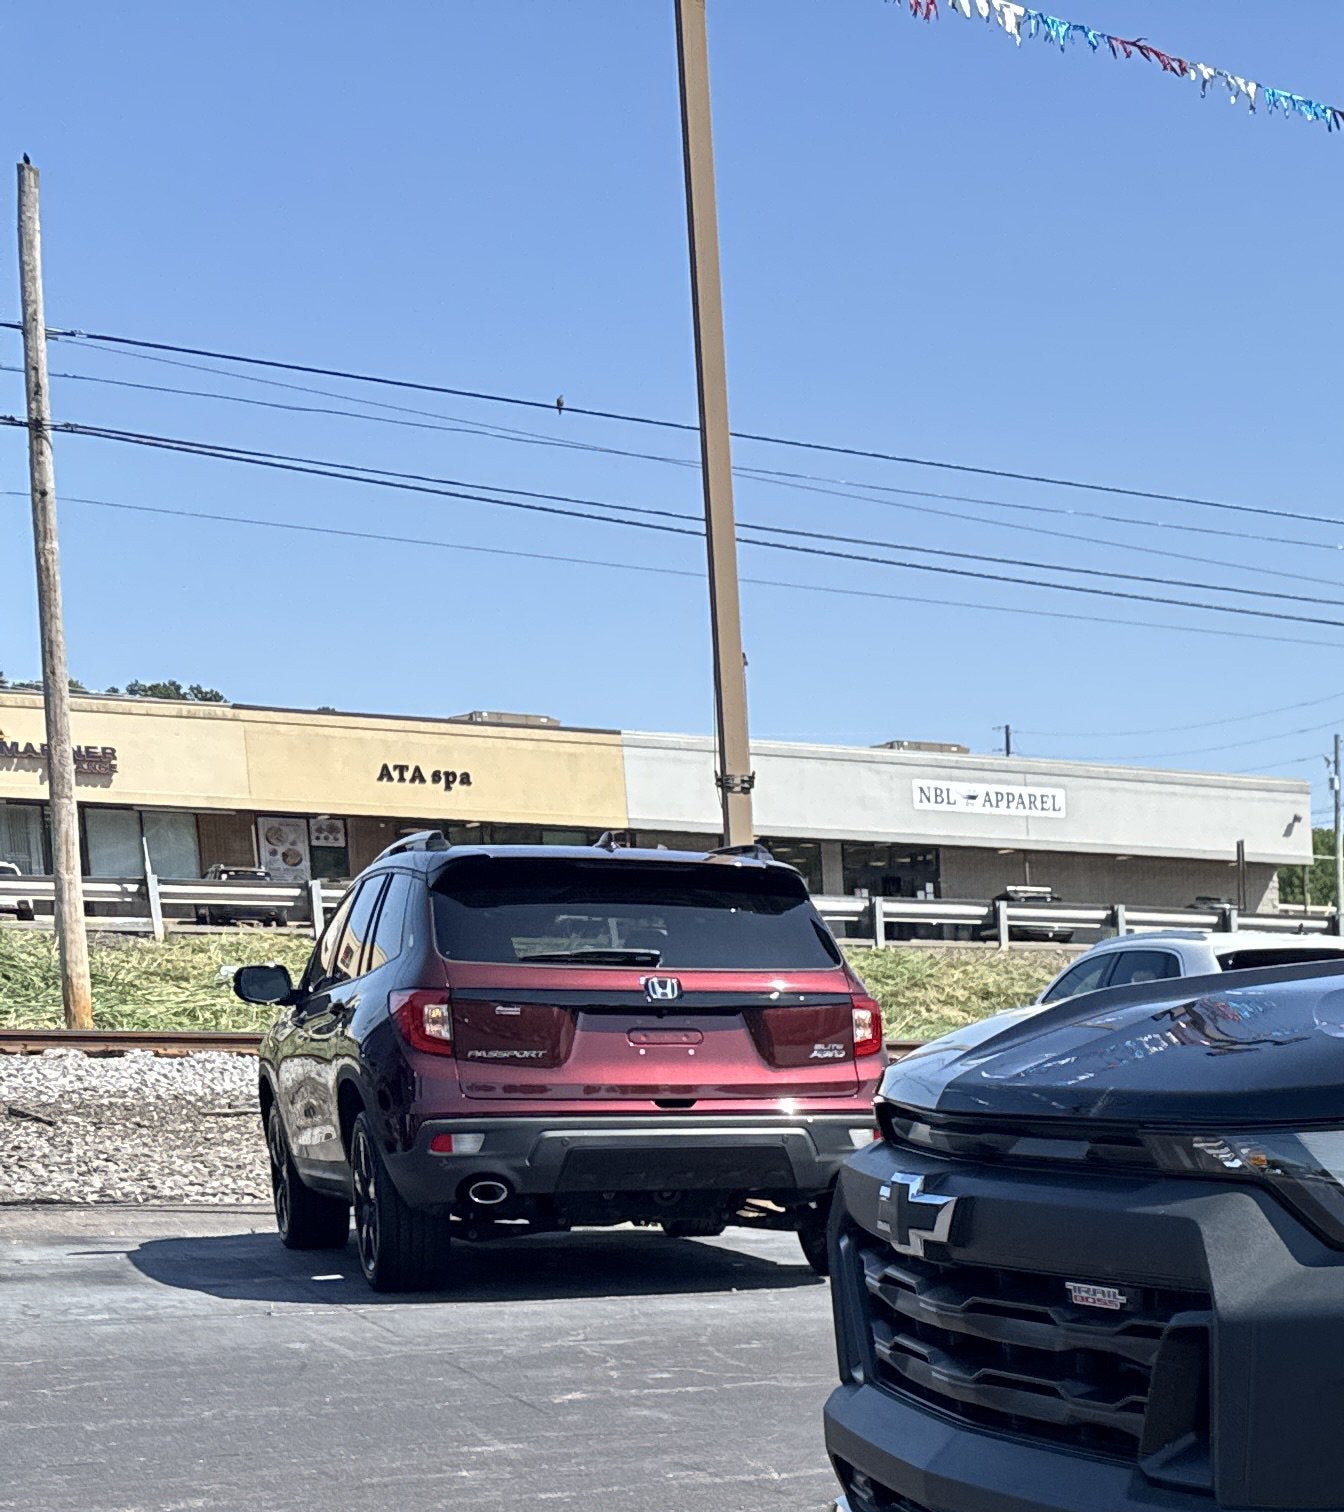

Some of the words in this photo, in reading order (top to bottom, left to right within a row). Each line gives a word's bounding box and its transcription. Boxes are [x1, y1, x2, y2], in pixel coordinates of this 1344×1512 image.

[0, 740, 117, 761] MANER
[376, 763, 426, 784] ATA
[431, 769, 472, 792] spa
[918, 786, 956, 805] NBL
[982, 791, 1061, 812] APPAREL
[467, 1050, 547, 1058] PASSPORT
[1065, 1282, 1126, 1303] TRAIL
[1073, 1294, 1120, 1310] BOSS
